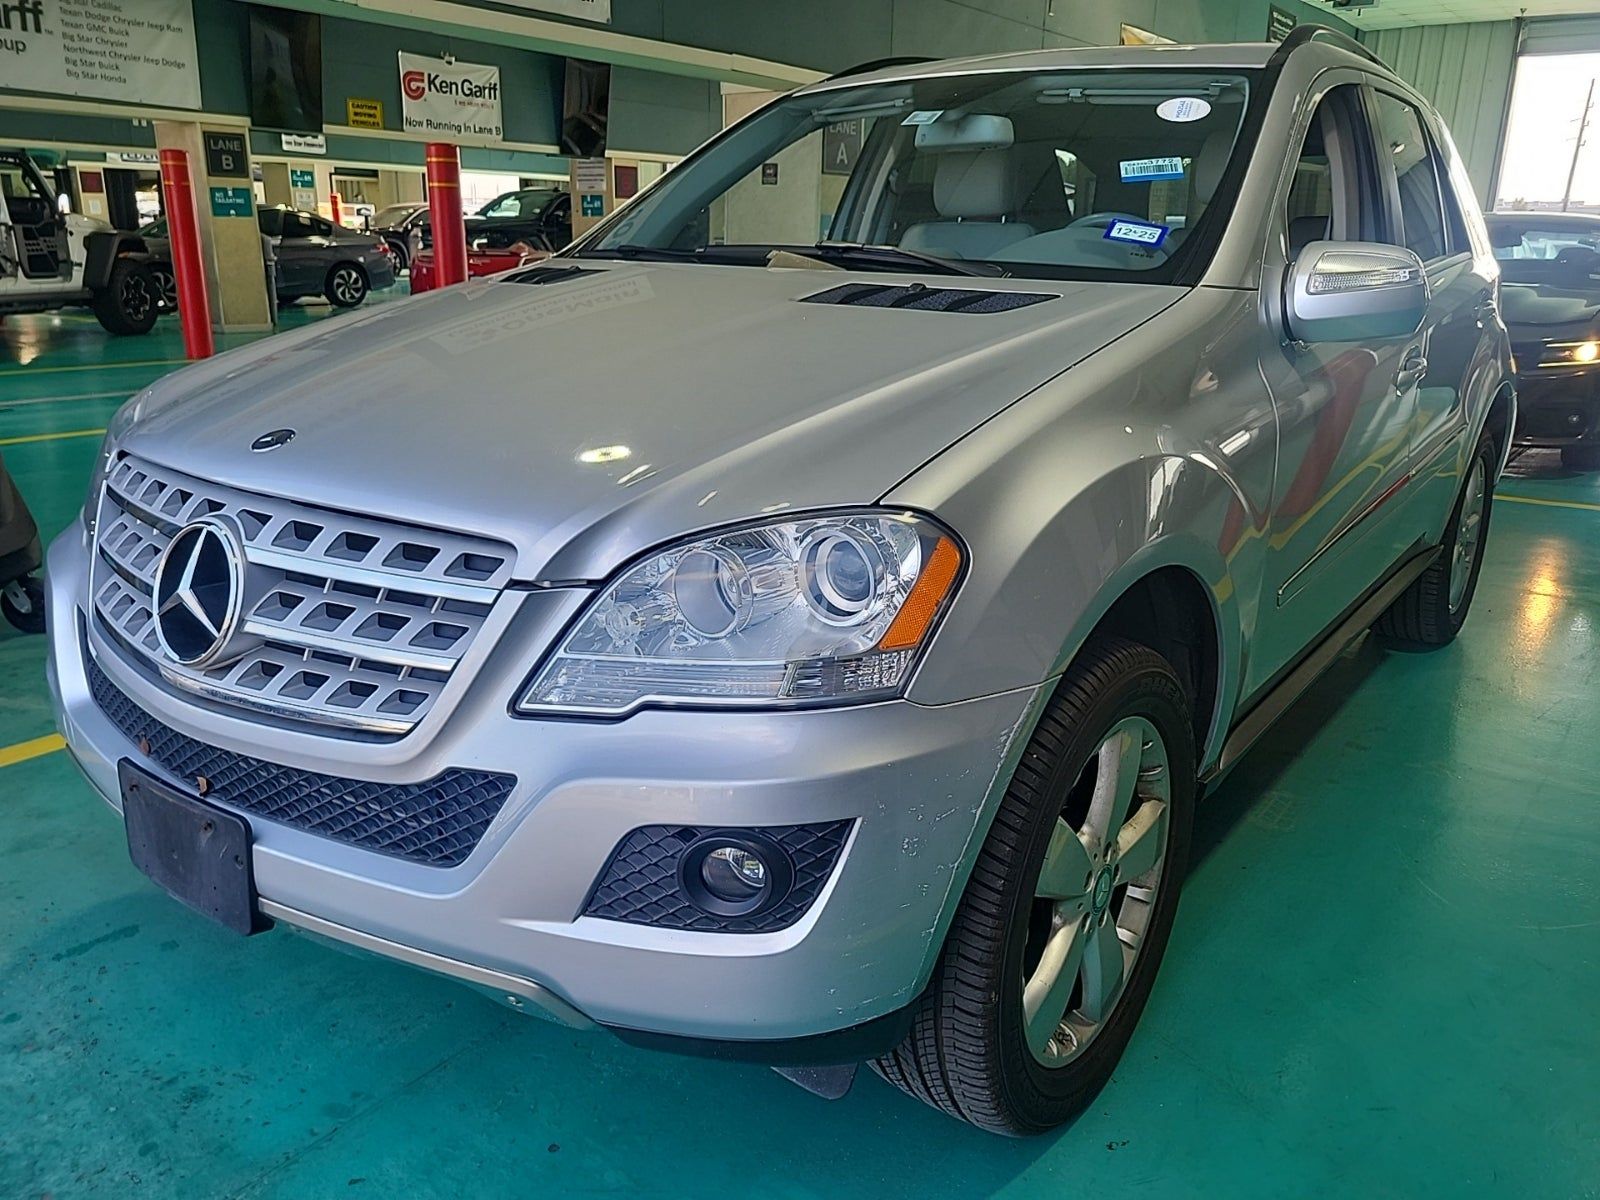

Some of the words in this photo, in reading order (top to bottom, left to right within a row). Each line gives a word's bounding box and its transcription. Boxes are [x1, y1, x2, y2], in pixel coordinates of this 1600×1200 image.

[0, 0, 43, 34] rff
[60, 7, 83, 17] Texan
[85, 11, 111, 22] Dodge
[113, 15, 145, 27] Chrysler
[147, 21, 165, 32] Jeep
[166, 24, 183, 33] Ram
[61, 19, 84, 30] Texan
[86, 23, 107, 33] GMC
[108, 26, 129, 37] Buick
[0, 38, 26, 55] up
[62, 31, 75, 42] Big
[77, 34, 92, 43] Star
[95, 36, 128, 48] Chrysler
[63, 44, 107, 57] Northwest
[109, 50, 141, 61] Chrysler
[143, 56, 160, 66] Jeep
[162, 58, 185, 69] Dodge
[65, 56, 78, 67] Big
[80, 59, 95, 68] Star
[98, 61, 120, 71] Buick
[66, 69, 79, 79] Big
[82, 71, 98, 80] Star
[100, 74, 127, 84] Honda
[427, 73, 458, 96] Ken
[461, 78, 498, 100] Garff
[351, 102, 378, 111] CAUTION
[405, 116, 424, 128] Now
[426, 118, 462, 135] Running
[473, 123, 493, 135] Lane
[494, 126, 502, 136] B
[210, 138, 242, 152] LANE
[837, 142, 848, 165] A
[222, 154, 234, 170] B
